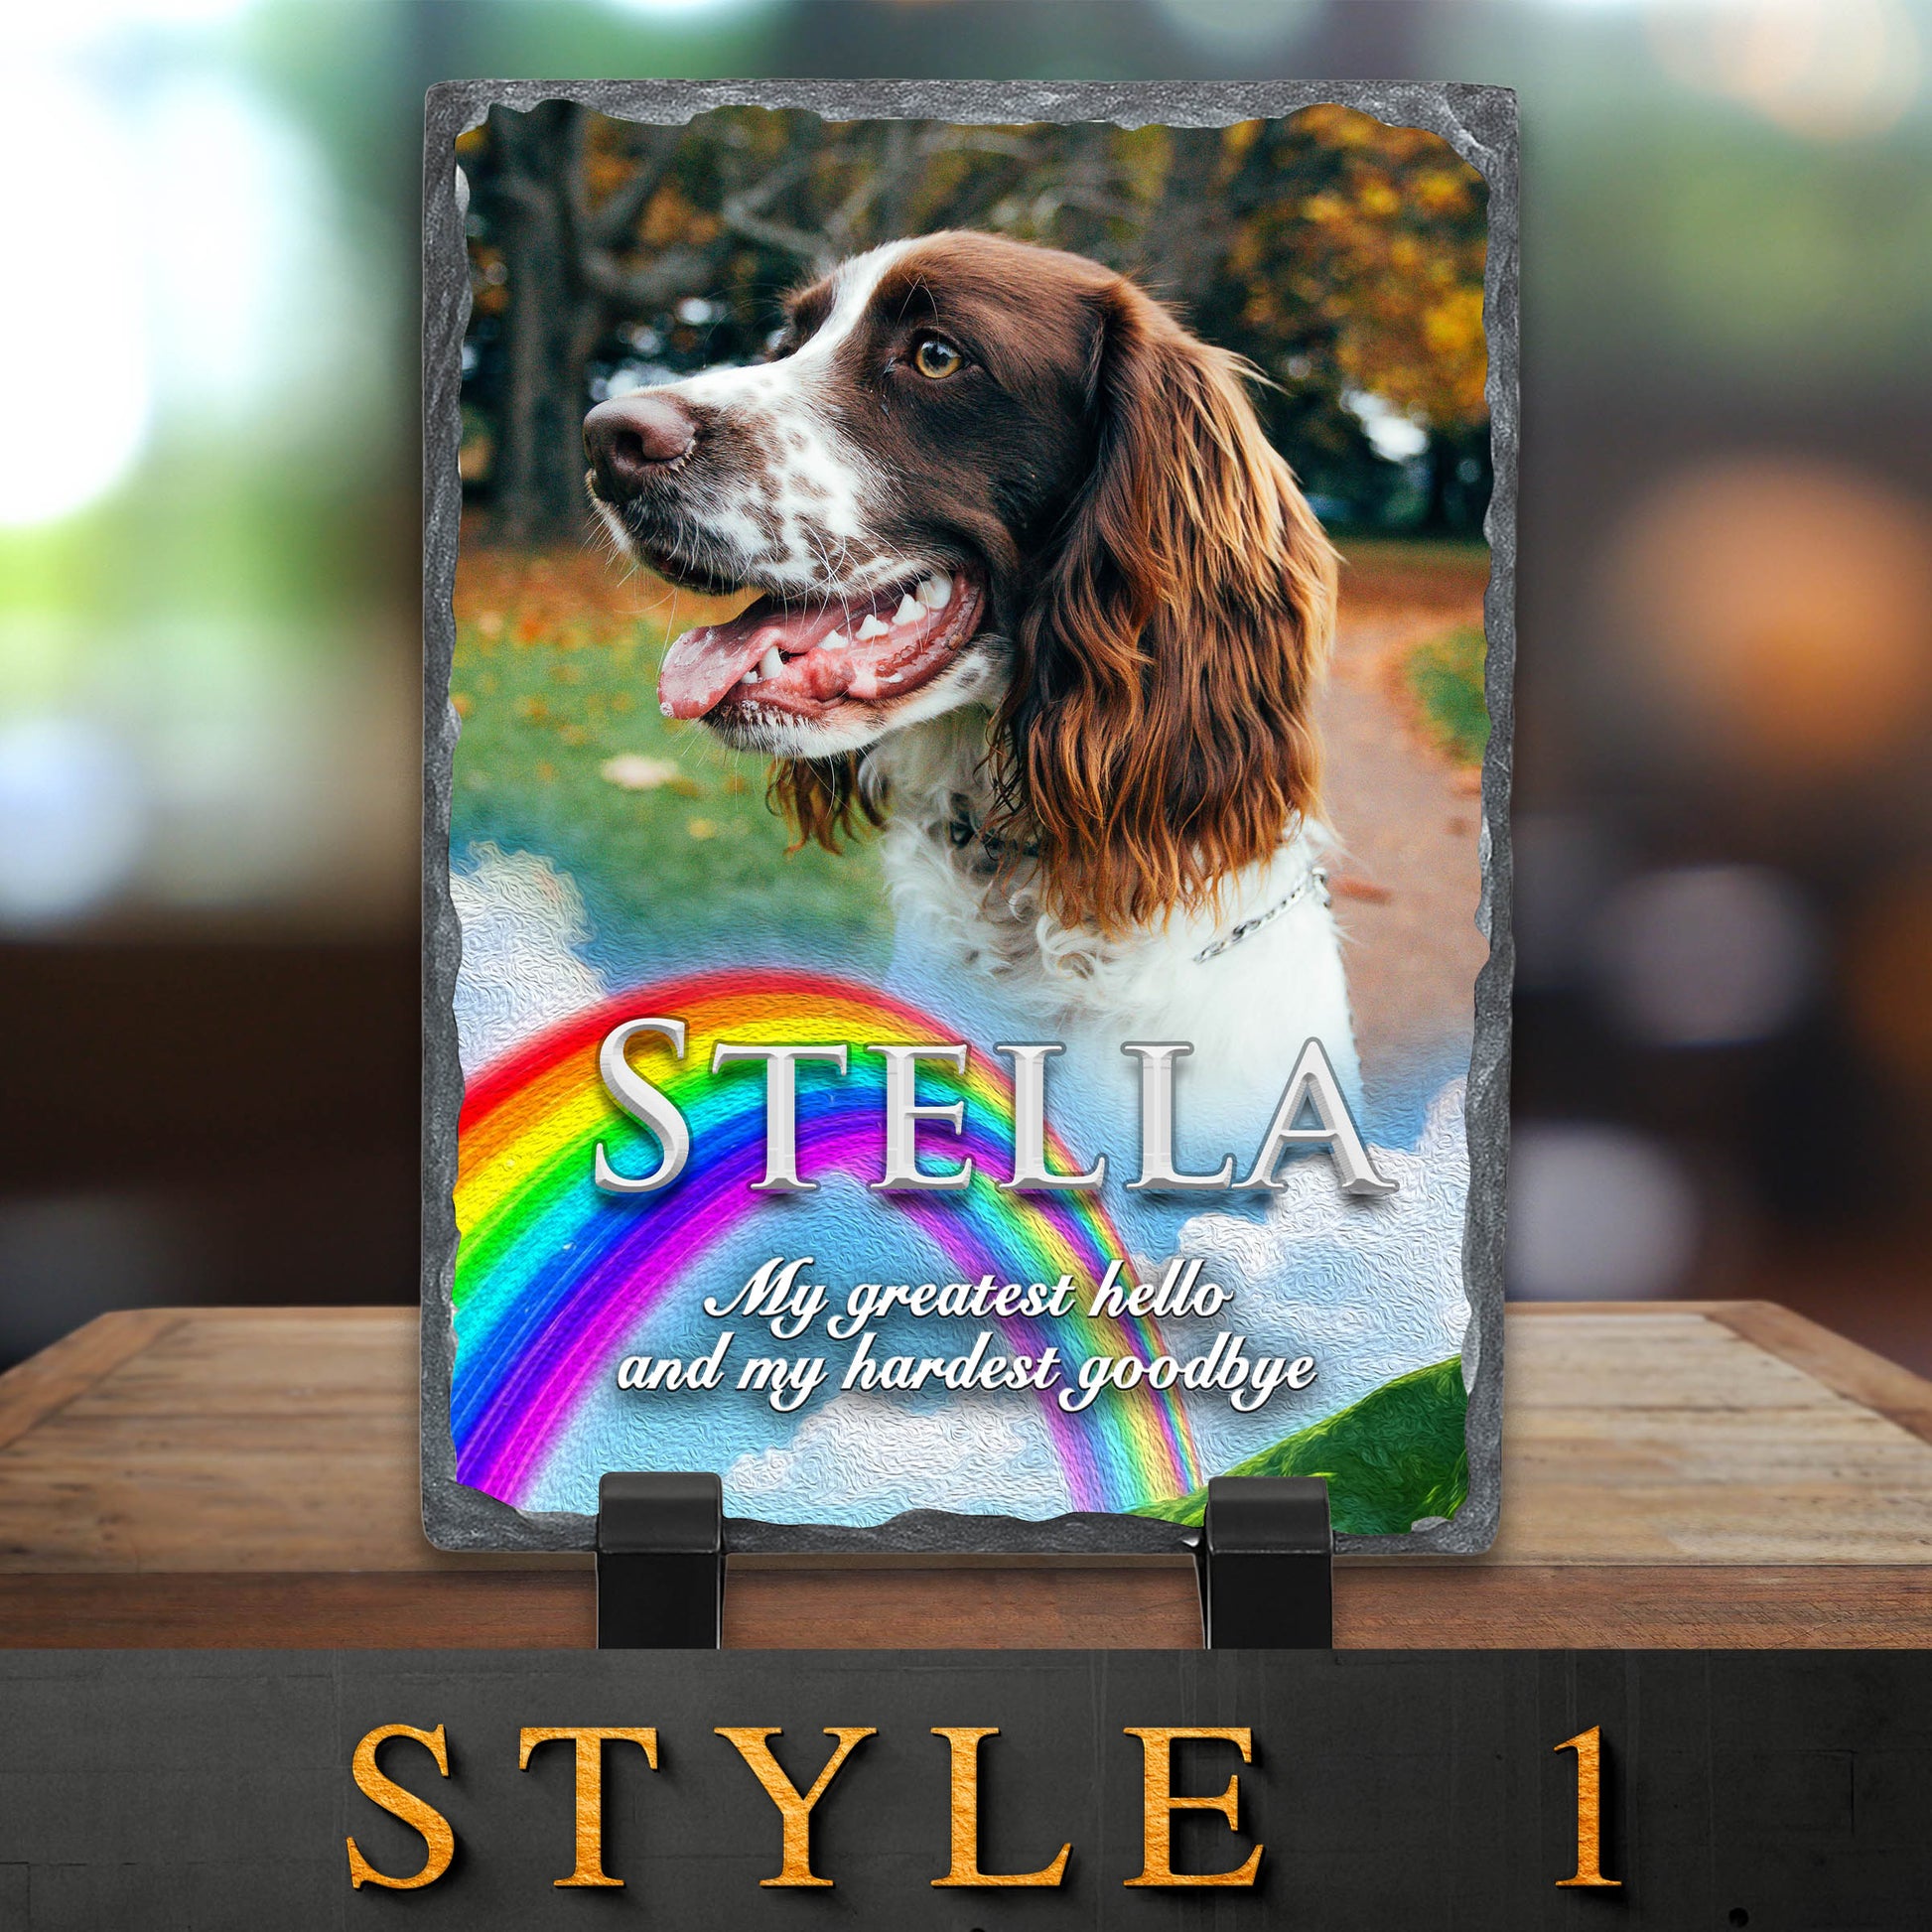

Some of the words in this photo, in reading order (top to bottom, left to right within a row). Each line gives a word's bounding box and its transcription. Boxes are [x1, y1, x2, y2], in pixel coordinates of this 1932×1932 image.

[595, 1018, 1397, 1194] STELLA
[703, 1256, 829, 1339] My
[827, 1276, 1076, 1341] greatest
[1088, 1258, 1234, 1318] hello
[617, 1331, 725, 1390] and
[736, 1352, 827, 1412] my
[840, 1333, 1064, 1391] hardest
[1059, 1334, 1317, 1413] goodbye
